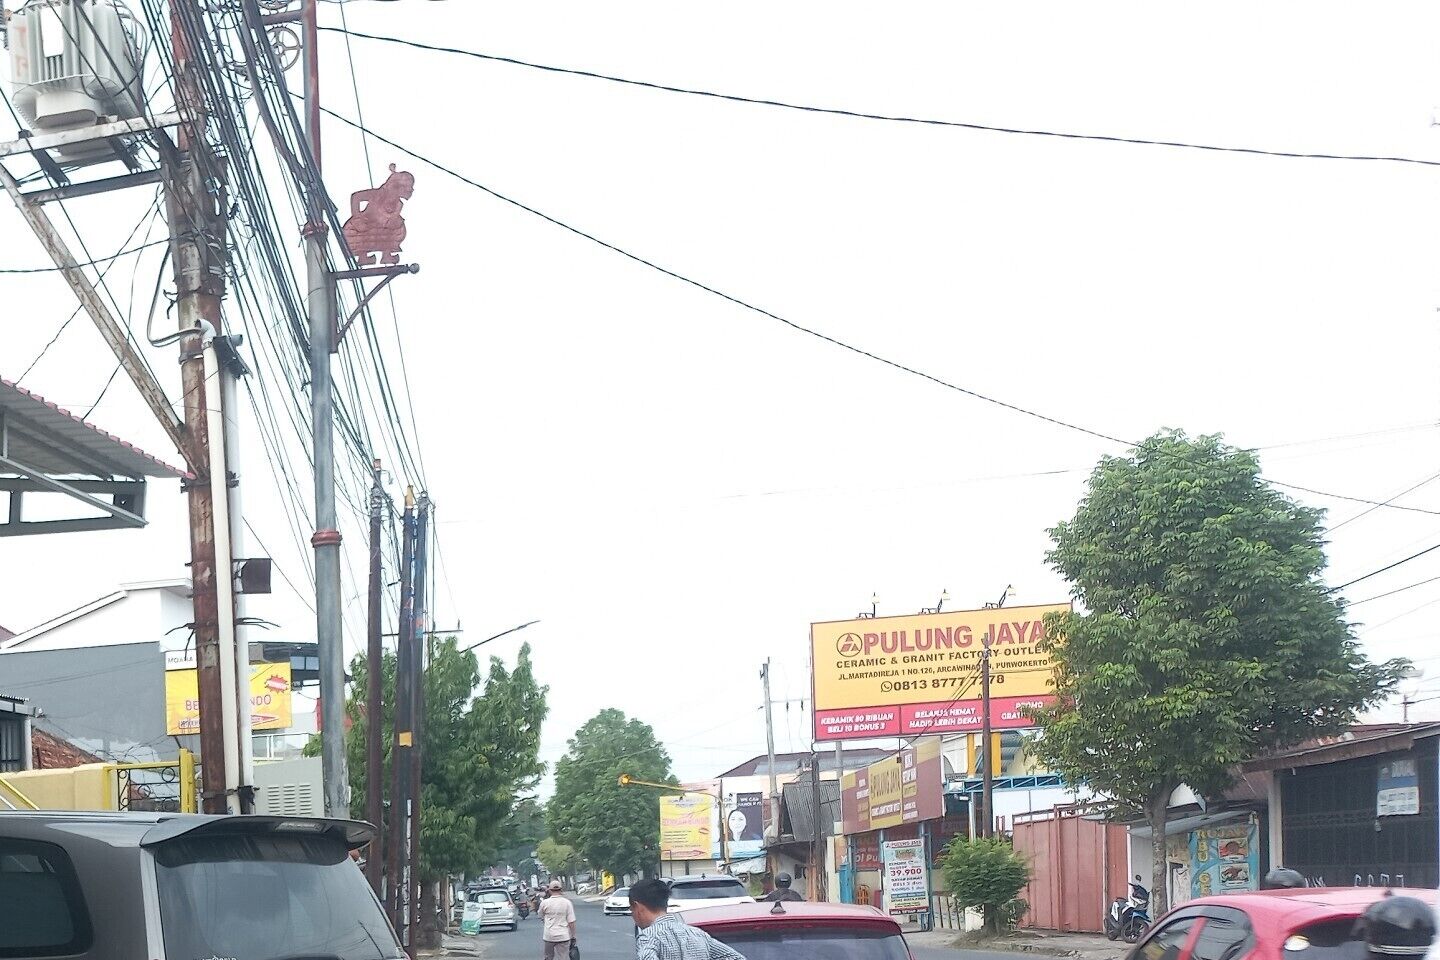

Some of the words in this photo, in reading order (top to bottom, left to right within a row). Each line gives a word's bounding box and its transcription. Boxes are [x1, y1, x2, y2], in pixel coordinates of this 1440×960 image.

[863, 624, 973, 656] PULUNG
[984, 620, 1047, 647] JAYA
[836, 657, 887, 669] CERAMIC
[890, 656, 899, 665] &
[902, 652, 945, 664] GRANIT
[995, 659, 1048, 669] PURWOKERTO
[893, 679, 928, 692] 0813
[931, 676, 965, 689] 8777
[890, 867, 922, 878] 39.900
